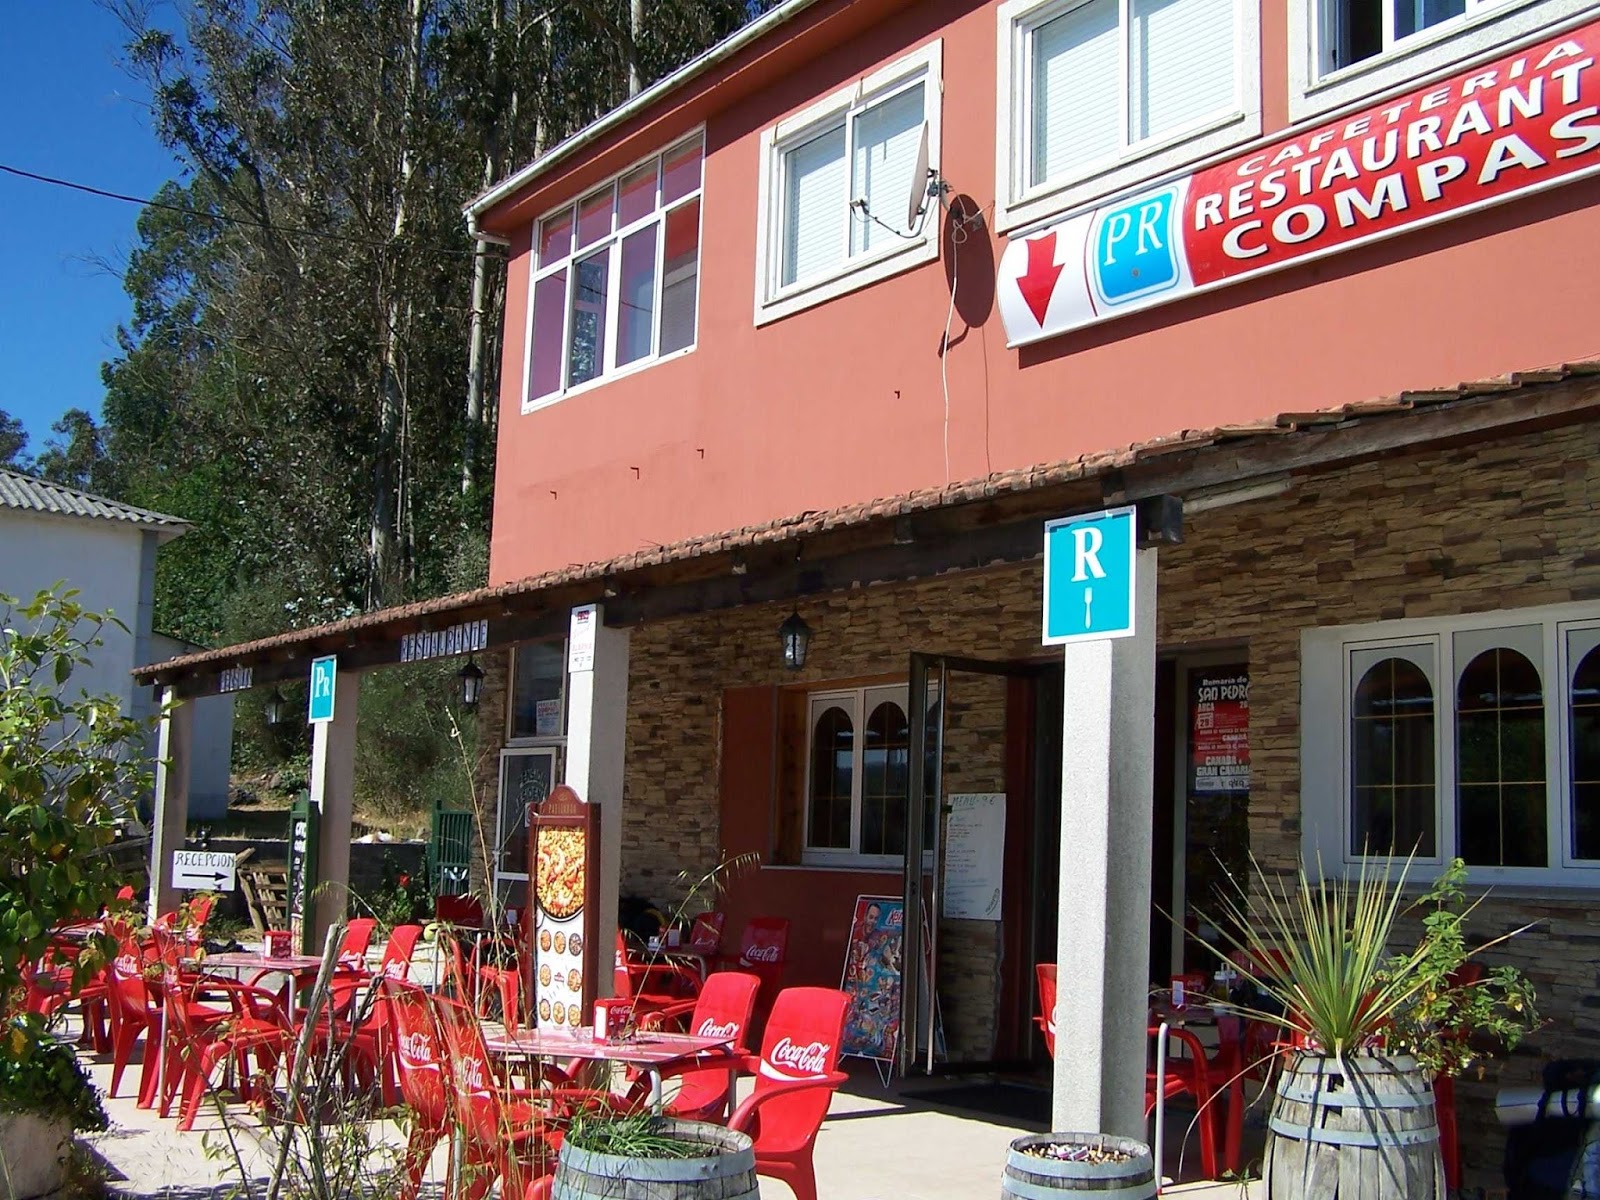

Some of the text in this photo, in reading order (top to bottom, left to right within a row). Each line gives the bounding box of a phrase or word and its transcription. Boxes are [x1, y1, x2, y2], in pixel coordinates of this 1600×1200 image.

[1236, 40, 1585, 177] CAFETERIA
[1195, 57, 1594, 231] RESTAURANT
[1221, 106, 1600, 260] COMPAS
[1104, 199, 1164, 267] PR
[1070, 526, 1107, 582] R
[401, 622, 487, 660] RESTAURANTE
[1198, 686, 1218, 702] SAN
[175, 852, 235, 867] RECEPCION
[770, 1037, 831, 1074] Coca-Cola
